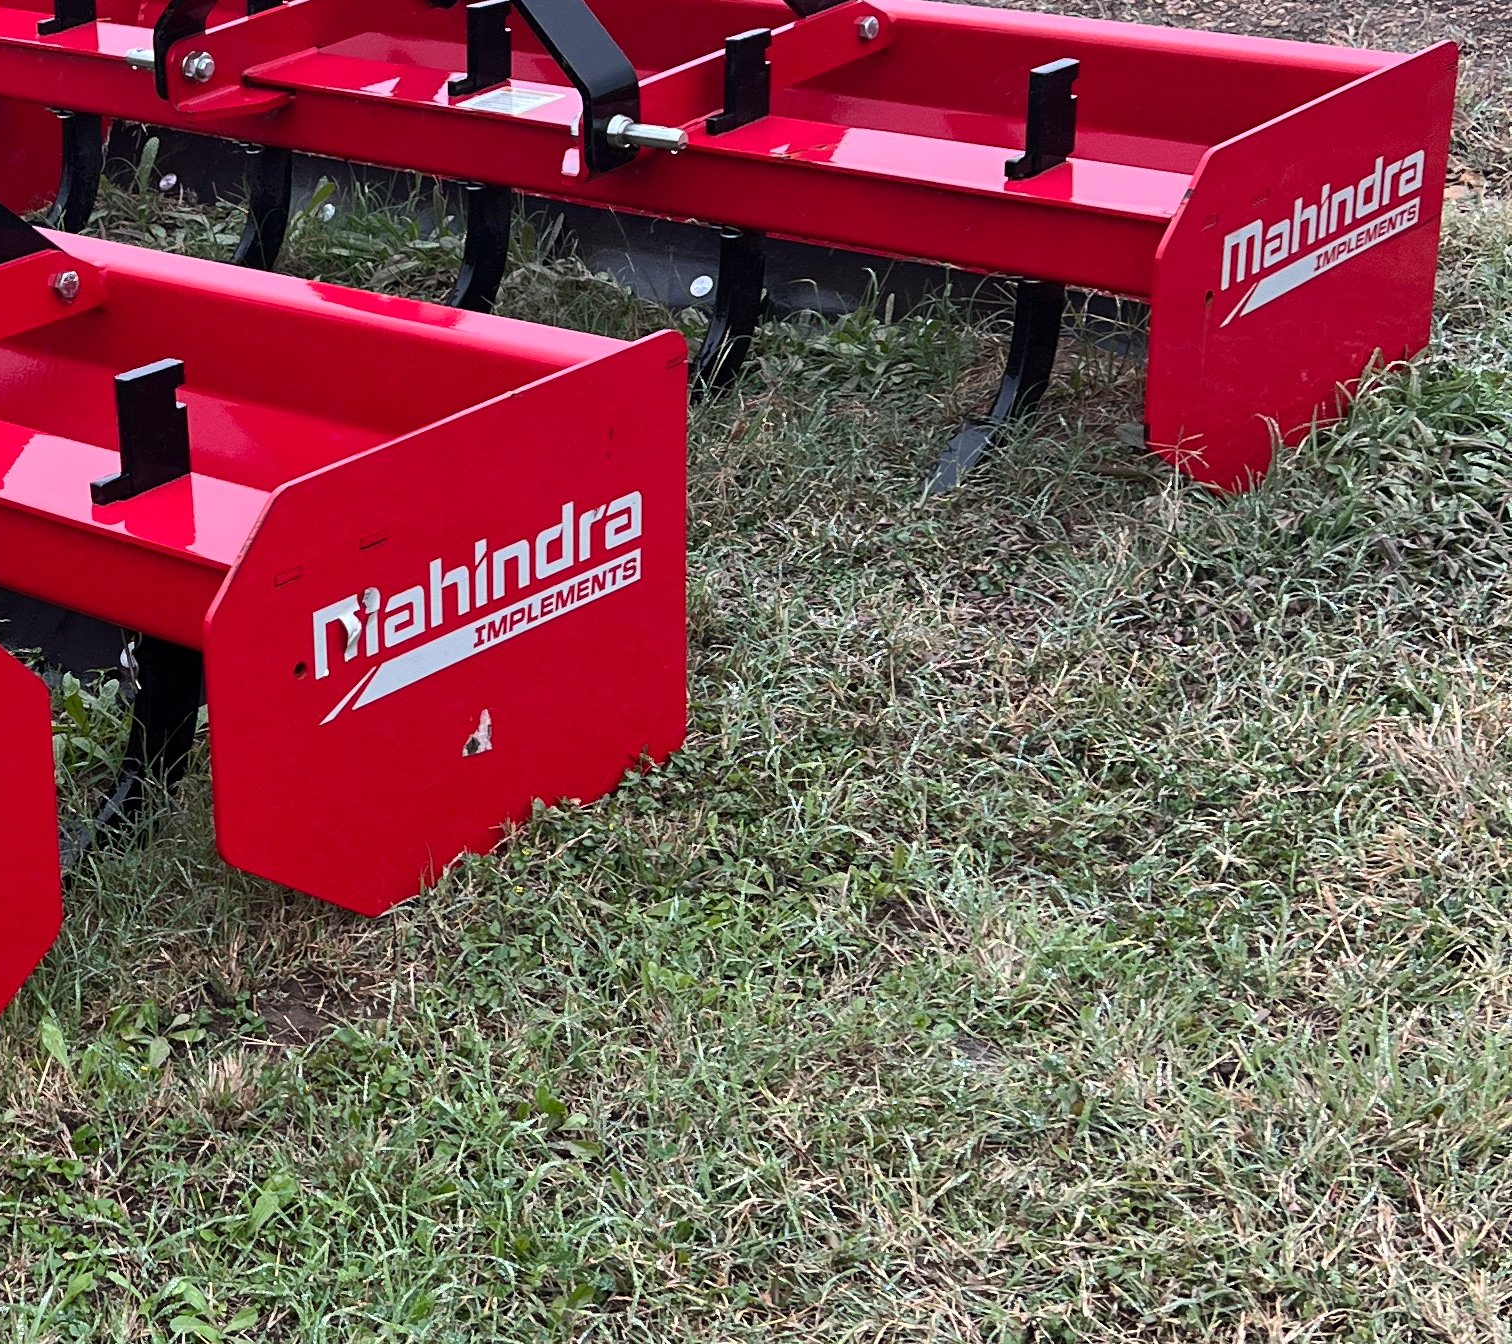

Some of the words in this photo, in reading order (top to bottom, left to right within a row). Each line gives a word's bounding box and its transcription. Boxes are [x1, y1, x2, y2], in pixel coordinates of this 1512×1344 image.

[1220, 150, 1425, 291] Mahindra
[1313, 205, 1418, 272] IMPLEMENTS
[313, 490, 642, 680] Mahindra
[473, 557, 638, 649] IMPLEMENTS
